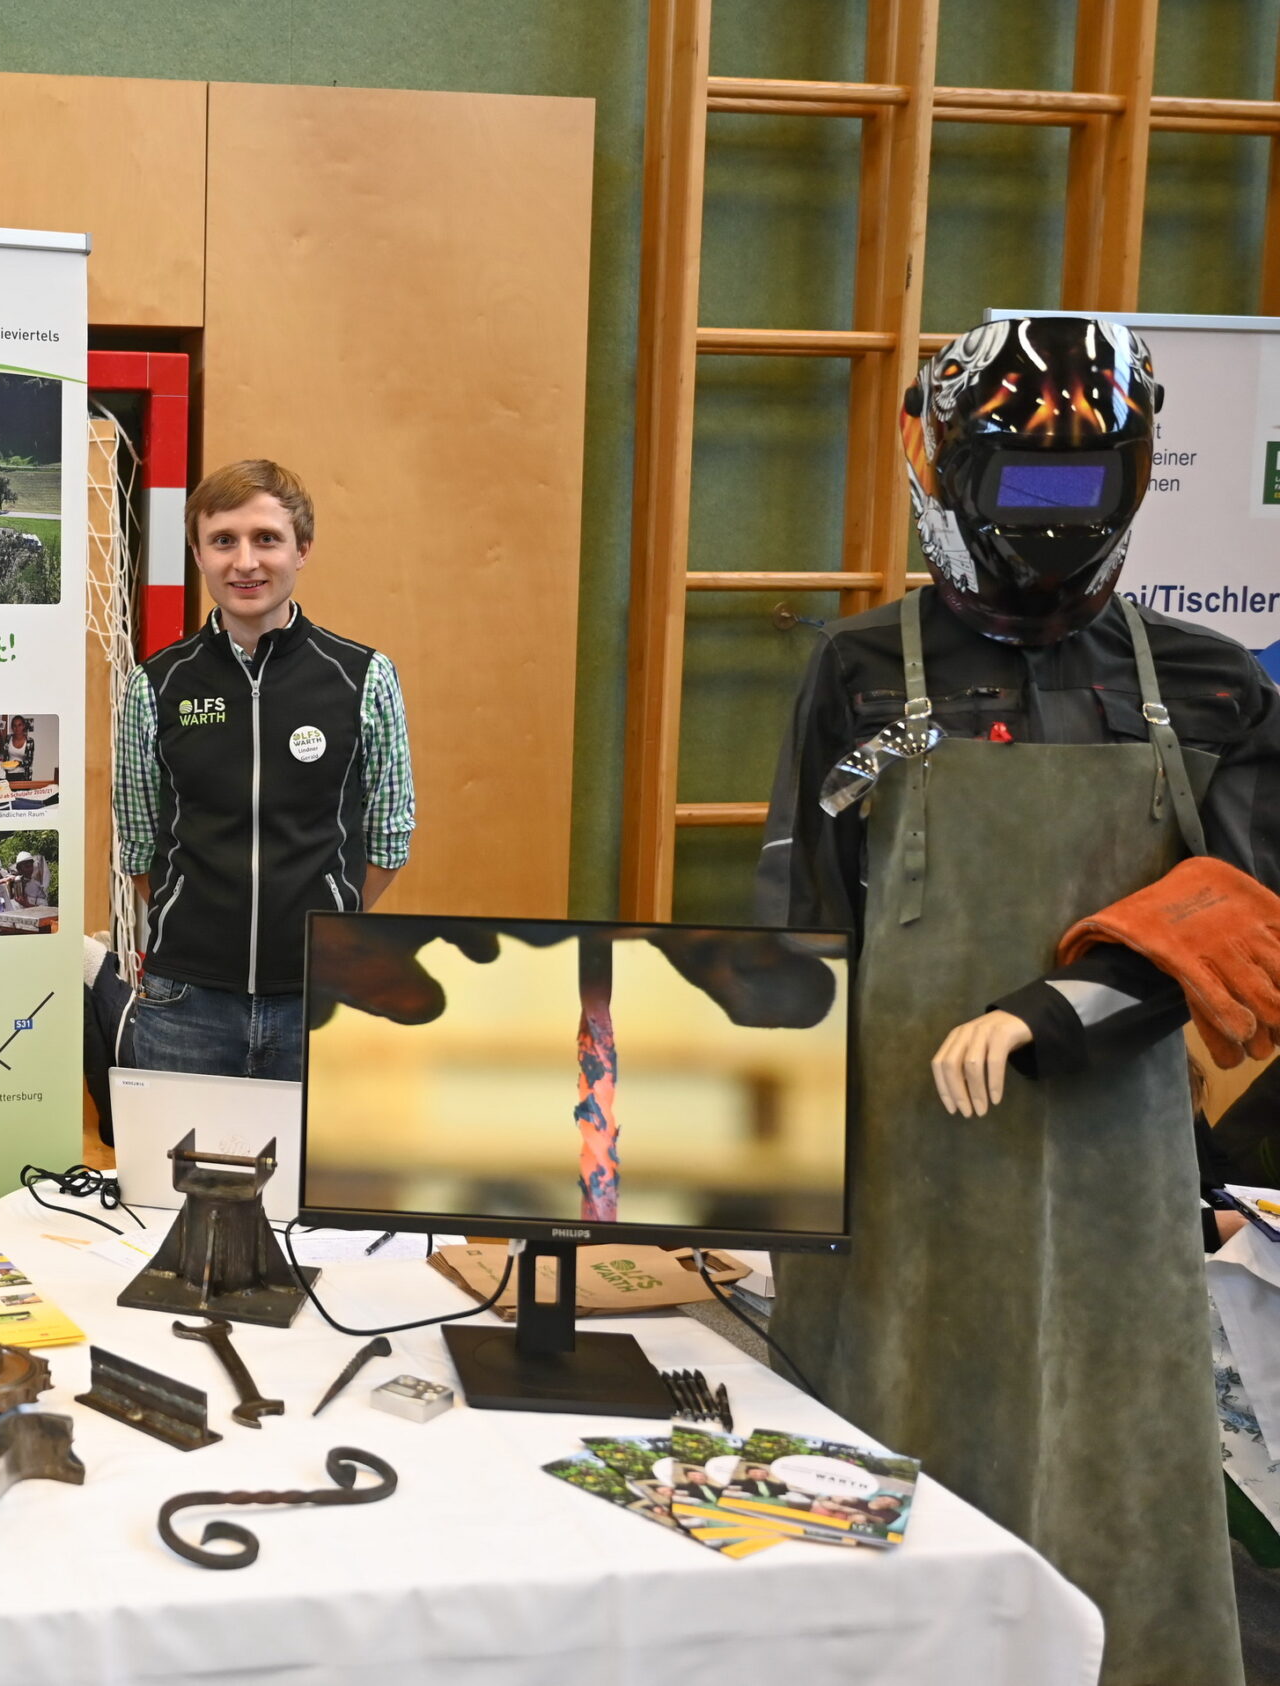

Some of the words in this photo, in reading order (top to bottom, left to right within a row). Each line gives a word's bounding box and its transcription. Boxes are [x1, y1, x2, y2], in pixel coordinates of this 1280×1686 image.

[1119, 585, 1280, 613] i/Tischler
[193, 697, 226, 714] LFS
[179, 712, 226, 726] WARTH
[301, 730, 321, 740] LFS
[293, 738, 322, 747] WARTH
[15, 1019, 31, 1029] S31
[551, 1228, 591, 1239] PHILIPS
[590, 1261, 639, 1294] WARTH
